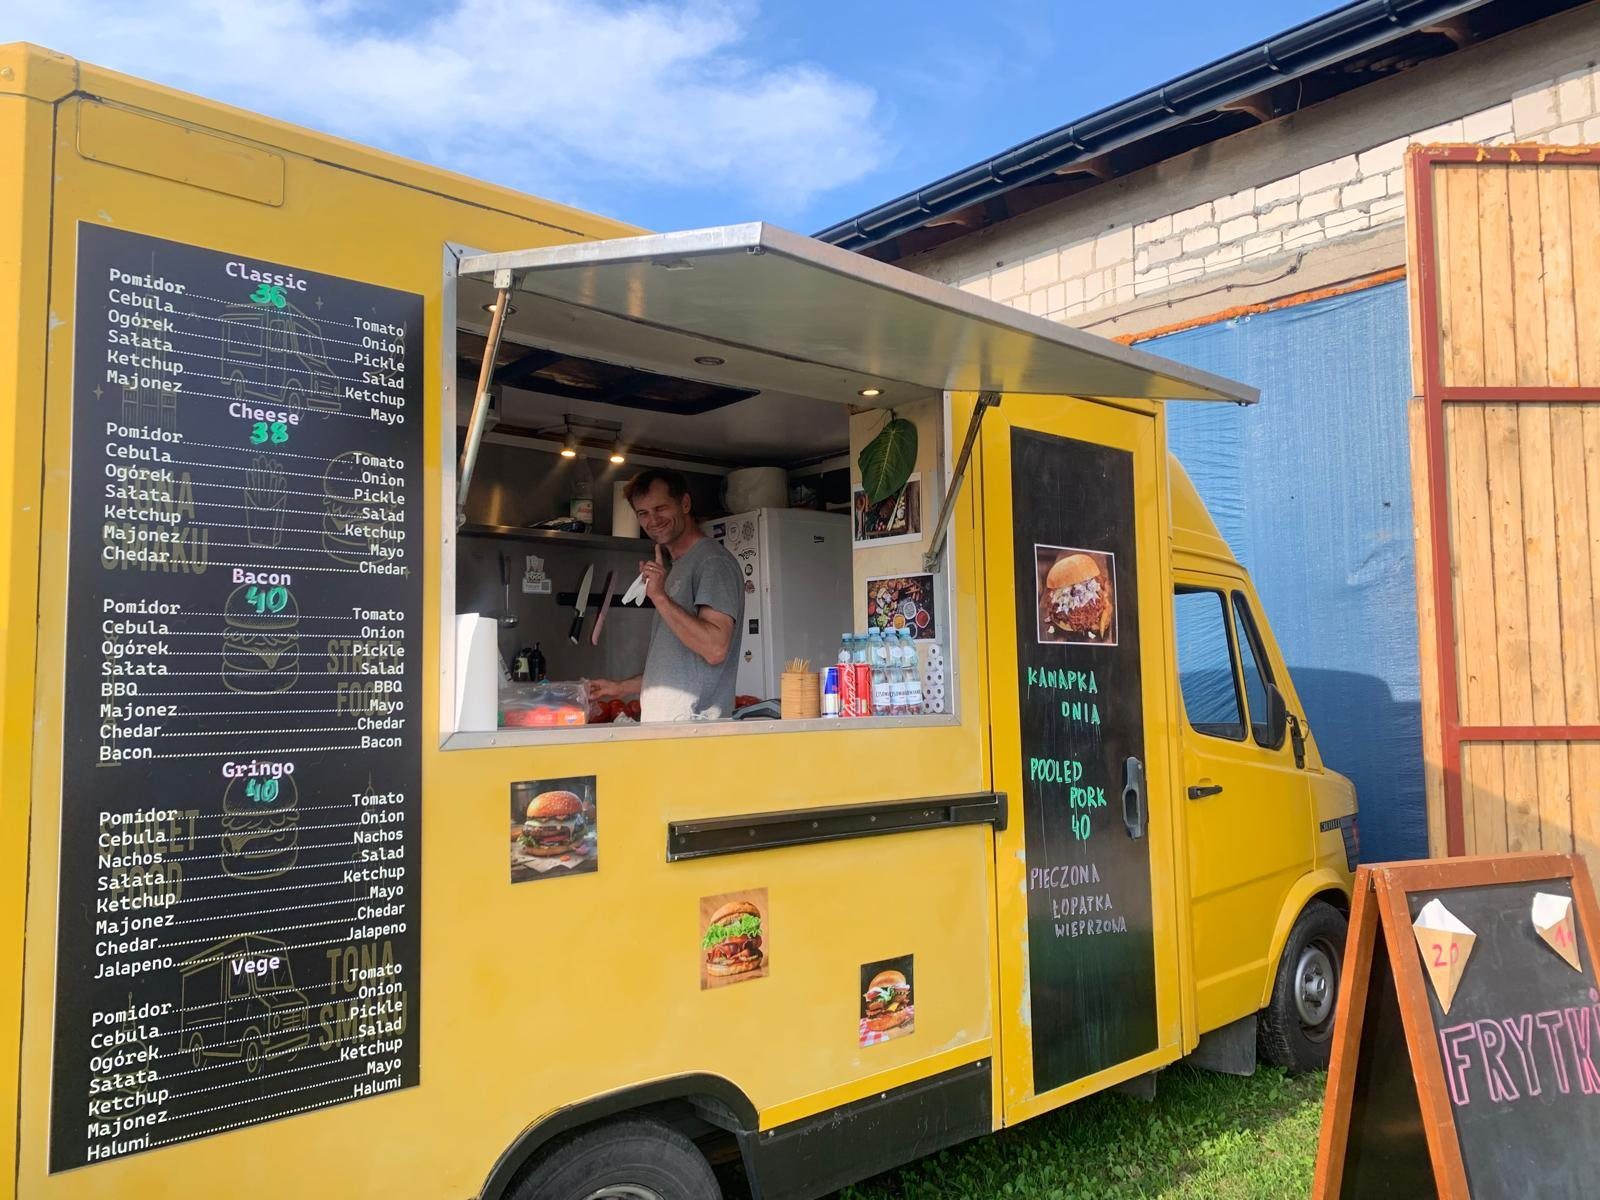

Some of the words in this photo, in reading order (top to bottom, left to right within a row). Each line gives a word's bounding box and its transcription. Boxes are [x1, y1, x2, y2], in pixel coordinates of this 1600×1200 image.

[225, 262, 307, 292] Classic
[109, 268, 186, 294] Pomidor
[354, 317, 405, 337] Tomato
[250, 284, 287, 308] 36
[108, 289, 175, 314] Cebula
[362, 336, 404, 355] Onion
[108, 309, 174, 333] Ogórek
[354, 352, 405, 372] Pickle
[108, 330, 174, 352] Sałata
[362, 371, 404, 389] Salad
[107, 349, 184, 374] Ketchup
[345, 387, 405, 408] Ketchup
[106, 370, 183, 393] Majonez
[371, 408, 405, 425] Mayo
[228, 402, 299, 425] Cheese
[106, 422, 184, 444] Pomidor
[353, 453, 404, 469] Tomato
[249, 422, 289, 444] 38
[105, 443, 172, 463] Cebula
[362, 472, 405, 487] Onion
[105, 463, 172, 483] Ogórek
[354, 489, 405, 505] Pickle
[105, 484, 171, 503] Sałata
[362, 508, 404, 523] Salad
[104, 504, 181, 526] Ketchup
[345, 525, 406, 541] Ketchup
[103, 525, 181, 544] Majonez
[371, 544, 404, 558] Mayo
[103, 546, 170, 563] Chedar
[359, 561, 407, 576] Chedar
[233, 568, 291, 586] Bacon
[103, 599, 181, 615] Pomidor
[353, 608, 404, 622] Tomato
[245, 585, 288, 614] 40
[102, 620, 169, 635] Cebula
[361, 626, 404, 640] Onion
[102, 640, 169, 657] Ogórek
[353, 644, 405, 657] Pickle
[101, 662, 168, 676] Sałata
[361, 663, 404, 675] Salad
[1028, 666, 1098, 694] KANAPKA
[101, 682, 138, 698] BBQ
[374, 681, 403, 694] BBQ
[100, 704, 178, 720] Majonez
[370, 700, 404, 714] Mayo
[1061, 701, 1101, 725] DNIA
[100, 724, 162, 739] Chedar
[358, 717, 405, 730] Chedar
[100, 745, 153, 761] Bacon
[361, 736, 402, 748] Bacon
[222, 762, 295, 780] Gringo
[1030, 758, 1083, 783] POOLED
[245, 779, 280, 802] 40
[1070, 787, 1107, 809] PORK
[100, 809, 178, 826] Pomidor
[352, 792, 404, 806] Tomato
[99, 829, 166, 847] Cebula
[361, 811, 405, 825] Onion
[1071, 814, 1091, 840] 40
[99, 852, 163, 869] Nachos
[353, 828, 403, 844] Nachos
[97, 872, 165, 891] Sałata
[361, 847, 404, 862] Salad
[1031, 863, 1101, 890] PIECZONA
[97, 892, 176, 913] Ketchup
[344, 865, 405, 883] Ketchup
[96, 914, 175, 936] Majonez
[370, 884, 404, 901] Mayo
[95, 937, 158, 957] Chedar
[357, 903, 405, 920] Chedar
[94, 957, 173, 979] Jalapeno
[349, 921, 407, 941] Jalapeno
[231, 956, 280, 977] Vege
[1431, 942, 1460, 967] 20
[92, 1000, 172, 1027] Pomidor
[350, 962, 403, 981] Tomato
[91, 1025, 160, 1049] Cebula
[358, 981, 403, 999] Onion
[90, 1047, 160, 1073] Ogórek
[350, 1000, 403, 1019] Pickle
[89, 1069, 158, 1094] Sałata
[358, 1018, 403, 1038] Salad
[88, 1088, 169, 1117] Ketchup
[340, 1037, 403, 1061] Ketchup
[87, 1110, 168, 1139] Majonez
[366, 1057, 402, 1077] Mayo
[87, 1136, 150, 1162] Halumi
[353, 1076, 402, 1097] Halumi
